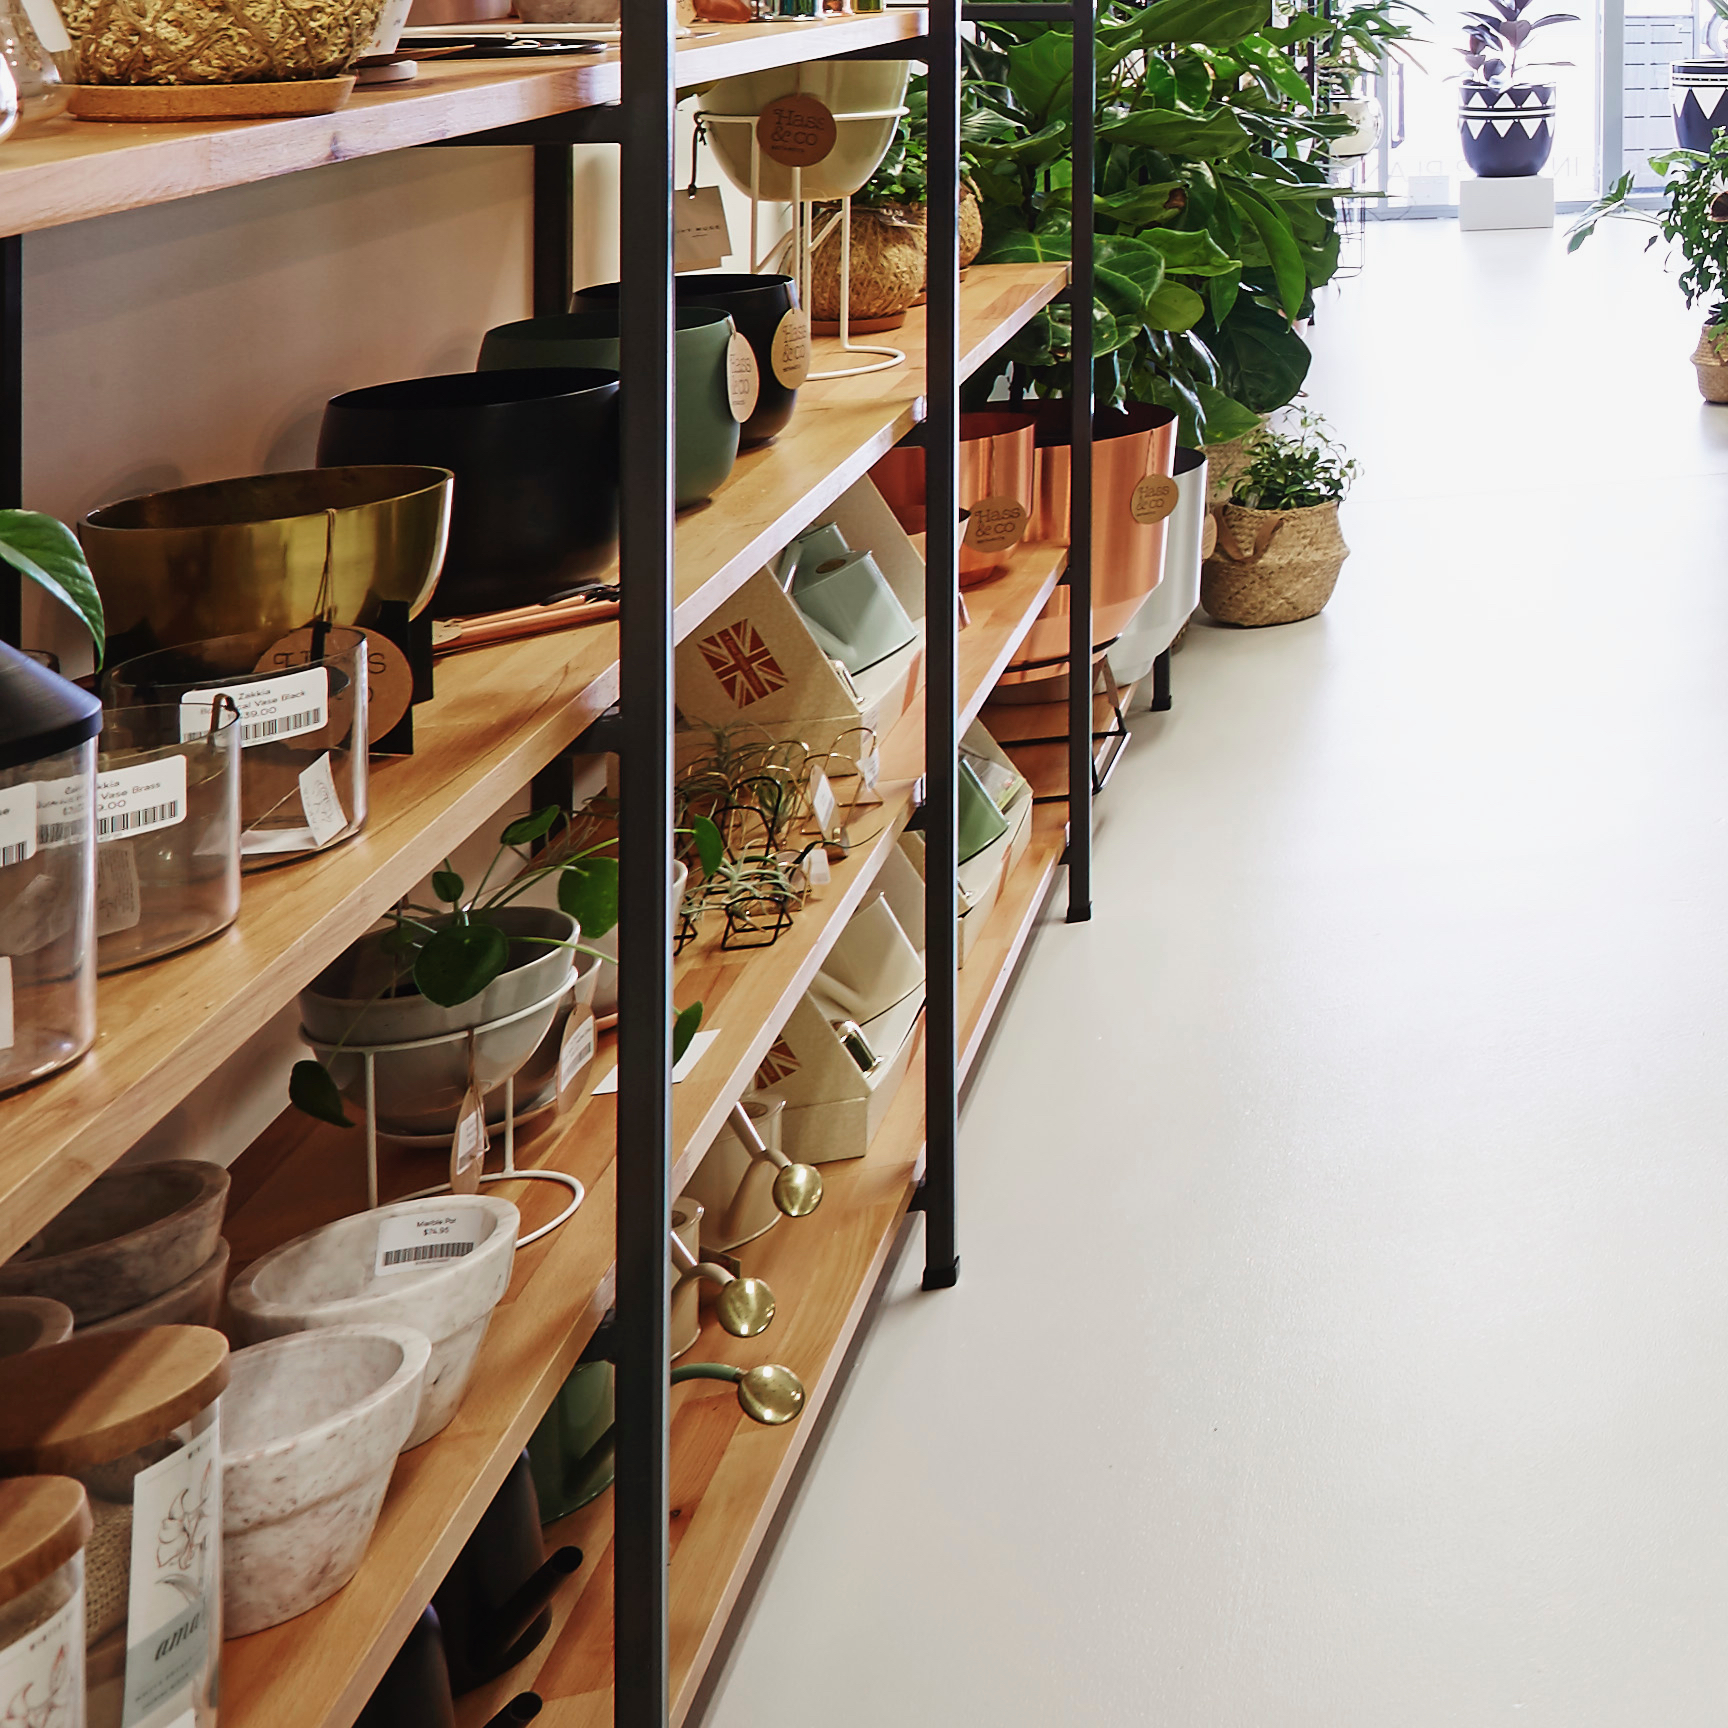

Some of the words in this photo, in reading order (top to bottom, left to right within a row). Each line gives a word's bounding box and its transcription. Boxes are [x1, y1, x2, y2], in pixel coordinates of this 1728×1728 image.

[773, 108, 825, 130] Hass
[975, 507, 1020, 523] Hass
[238, 688, 271, 700] Zakkia
[255, 697, 278, 707] Vase
[133, 782, 161, 794] Brass
